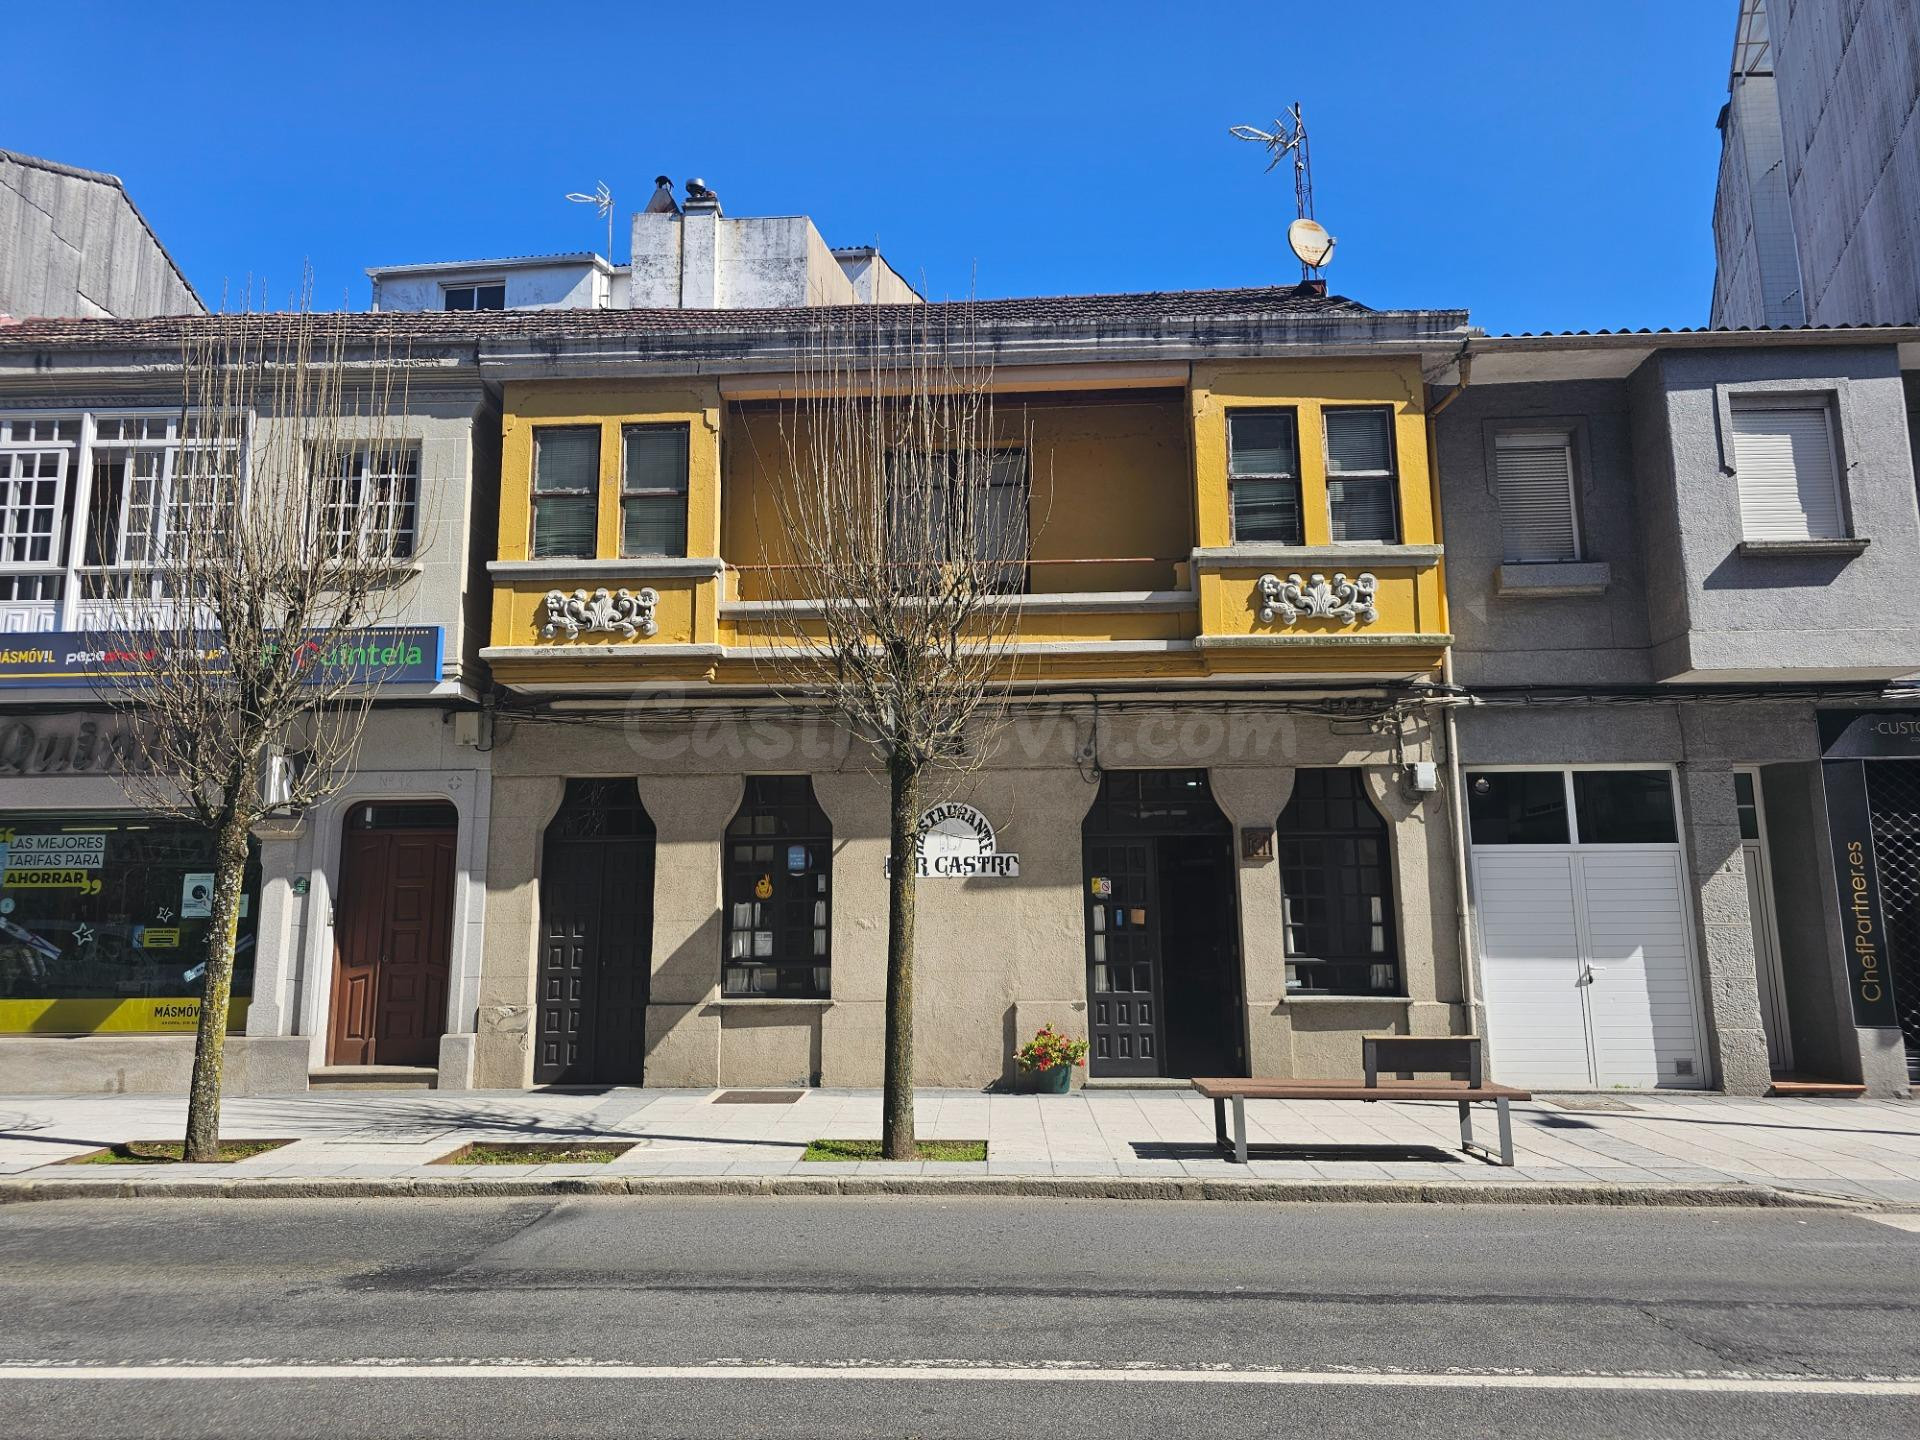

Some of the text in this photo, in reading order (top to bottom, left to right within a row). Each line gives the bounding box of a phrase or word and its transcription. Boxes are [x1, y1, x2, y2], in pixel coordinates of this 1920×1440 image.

[10, 837, 103, 849] LAS MEJORES
[8, 854, 100, 866] TARIFAS PARA
[5, 872, 84, 884] AHORRAR
[1847, 841, 1882, 1002] ChefPartner.es
[154, 1004, 200, 1018] MÁSMÓV
